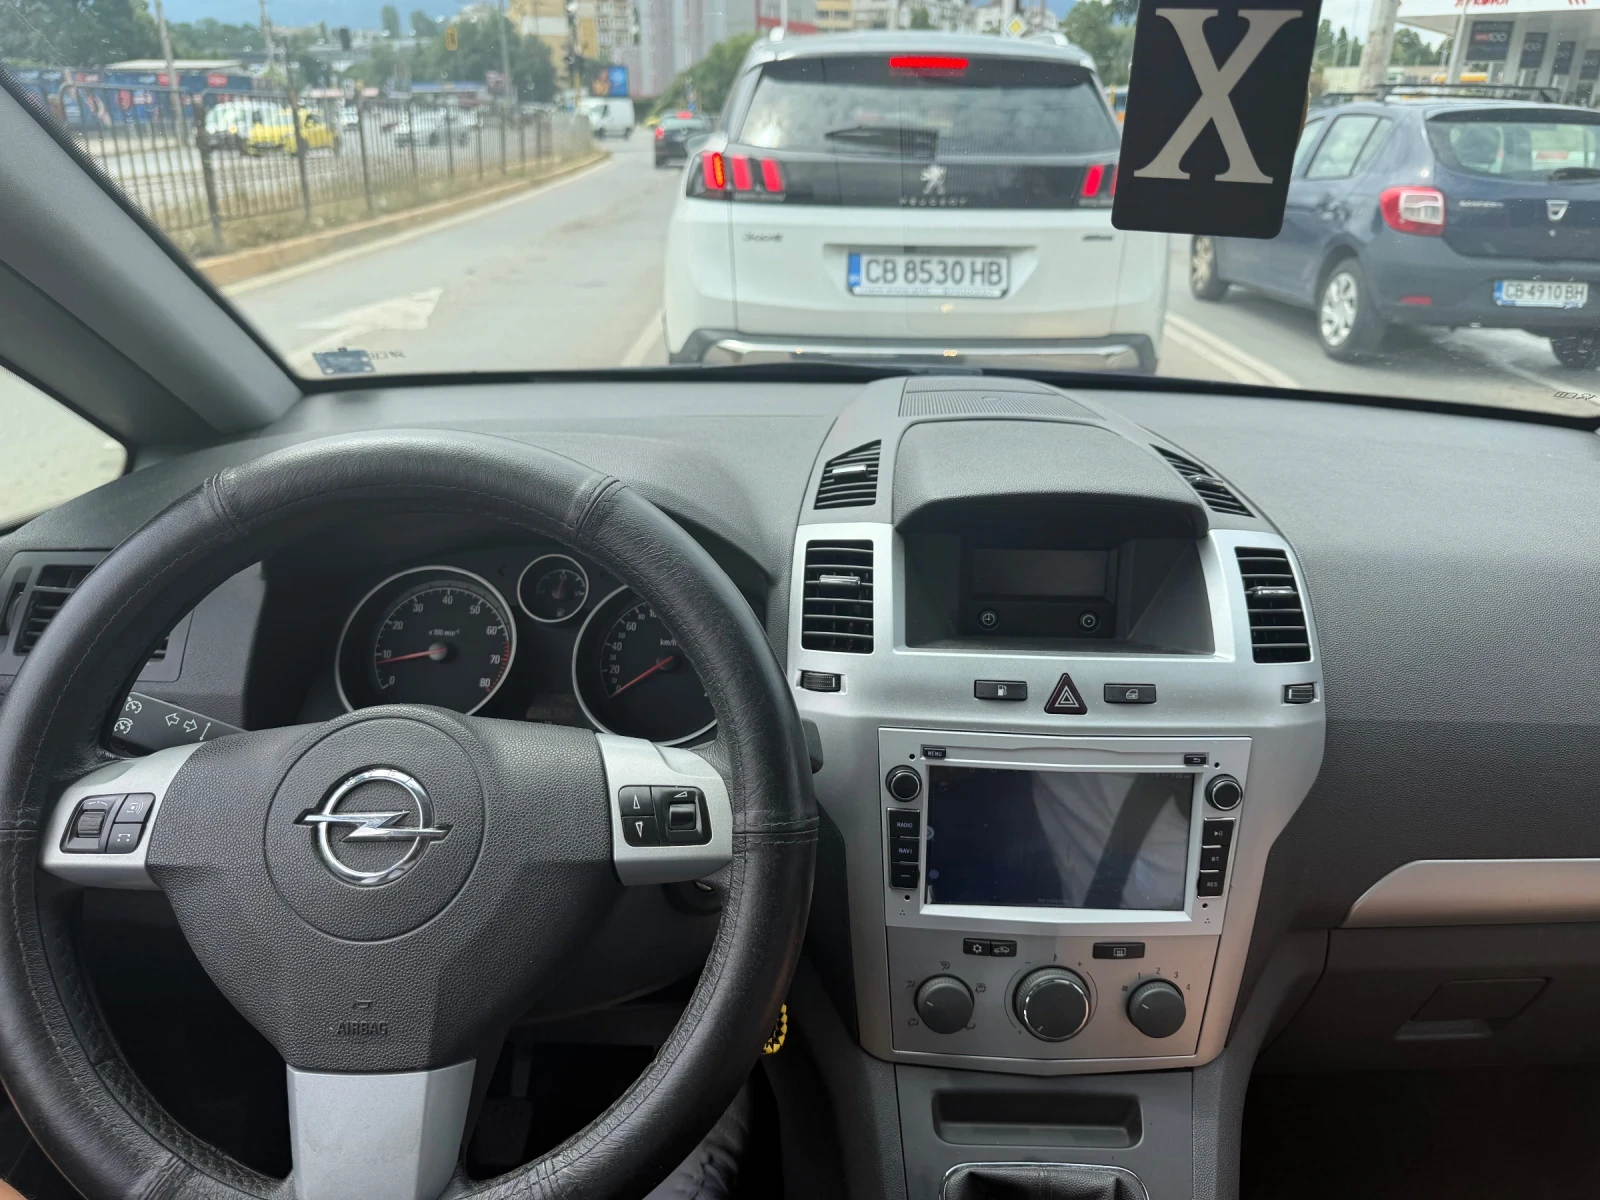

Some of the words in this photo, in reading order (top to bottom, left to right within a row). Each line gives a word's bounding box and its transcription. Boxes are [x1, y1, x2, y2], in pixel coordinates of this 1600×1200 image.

[1134, 8, 1303, 184] X
[865, 259, 897, 284] CB
[903, 260, 965, 285] 8530
[970, 262, 1002, 286] HB
[1527, 285, 1562, 300] 4910
[442, 595, 453, 605] 40
[413, 603, 424, 613] 30
[469, 605, 480, 615] 50
[392, 620, 403, 631] 20
[486, 625, 498, 636] 60
[626, 621, 637, 631] 60
[611, 641, 622, 651] 40
[660, 638, 677, 646] km/h
[383, 649, 392, 659] 10
[490, 654, 500, 664] 70
[610, 664, 620, 674] 20
[389, 675, 396, 685] 0
[479, 677, 491, 688] 80
[896, 821, 913, 829] RADIO
[1155, 966, 1161, 975] 2
[1173, 971, 1179, 979] 3
[1185, 983, 1191, 991] 4
[337, 1020, 388, 1035] AIRBAG
